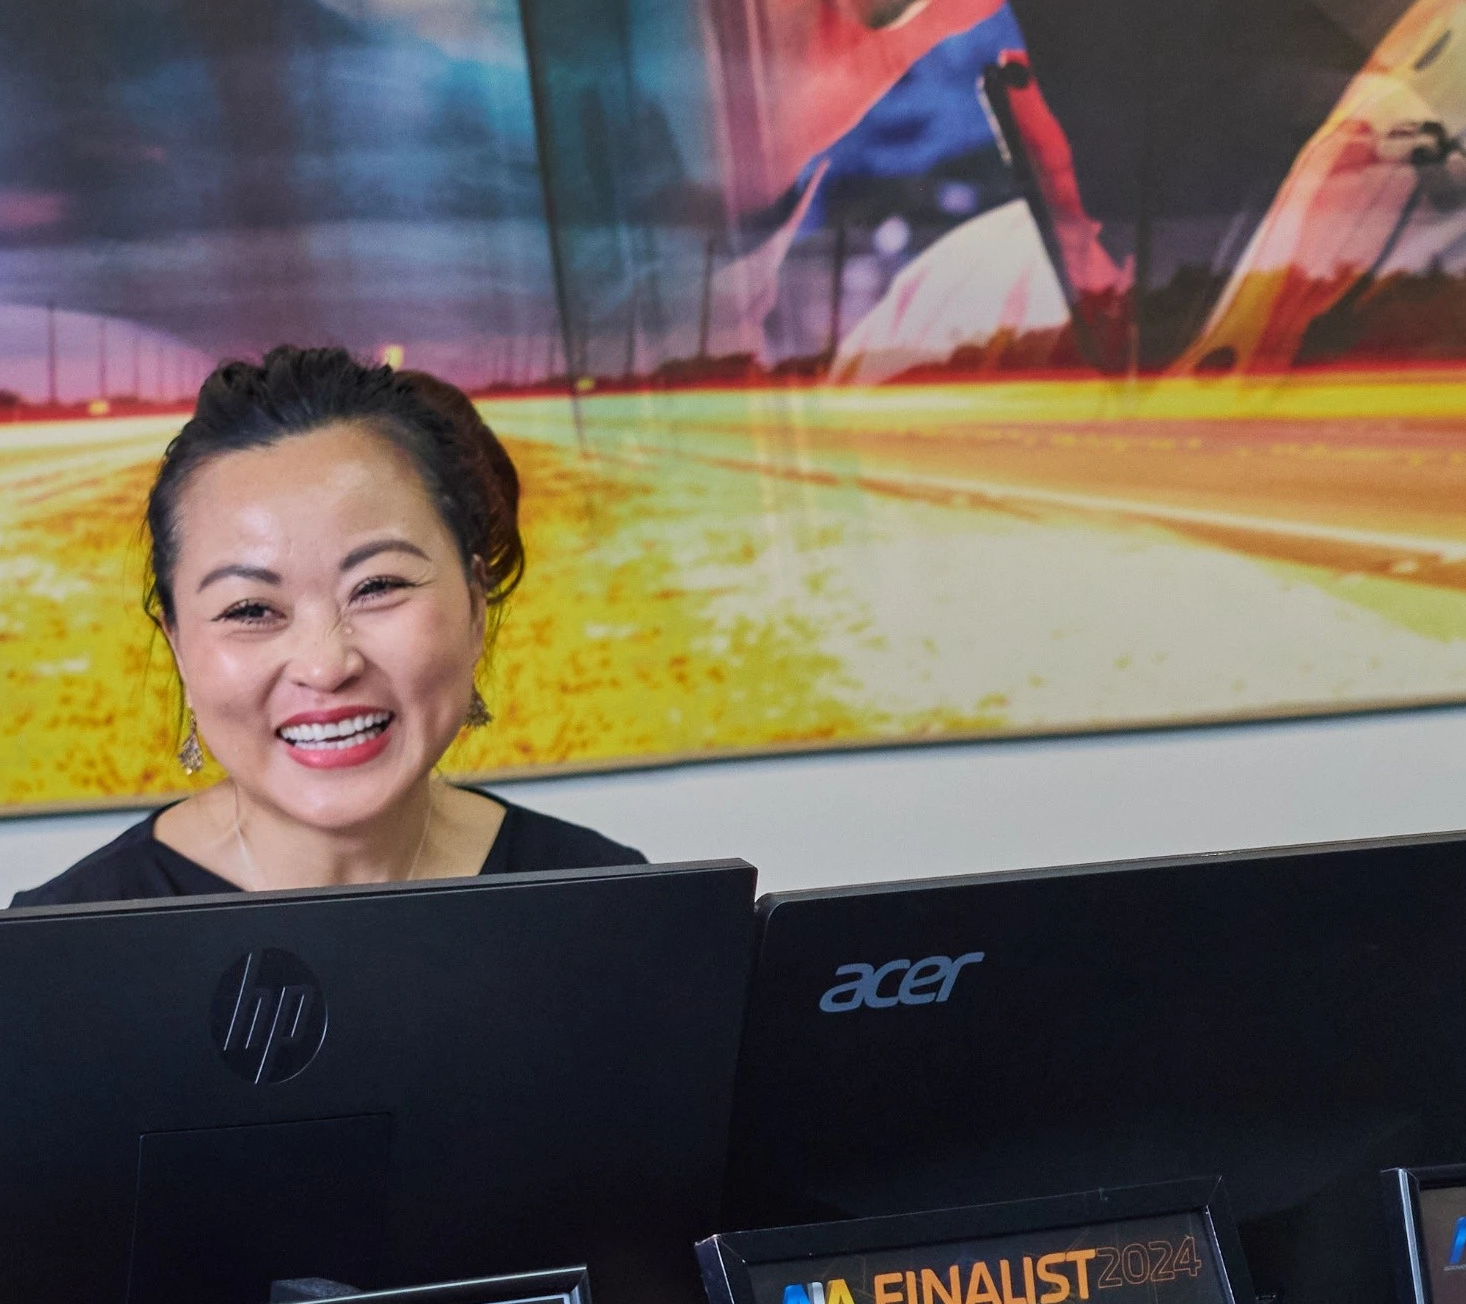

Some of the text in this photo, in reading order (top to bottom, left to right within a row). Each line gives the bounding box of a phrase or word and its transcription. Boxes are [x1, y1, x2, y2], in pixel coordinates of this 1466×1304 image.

[819, 950, 985, 1015] acer
[222, 950, 306, 1084] hp
[1096, 1234, 1203, 1289] 2024
